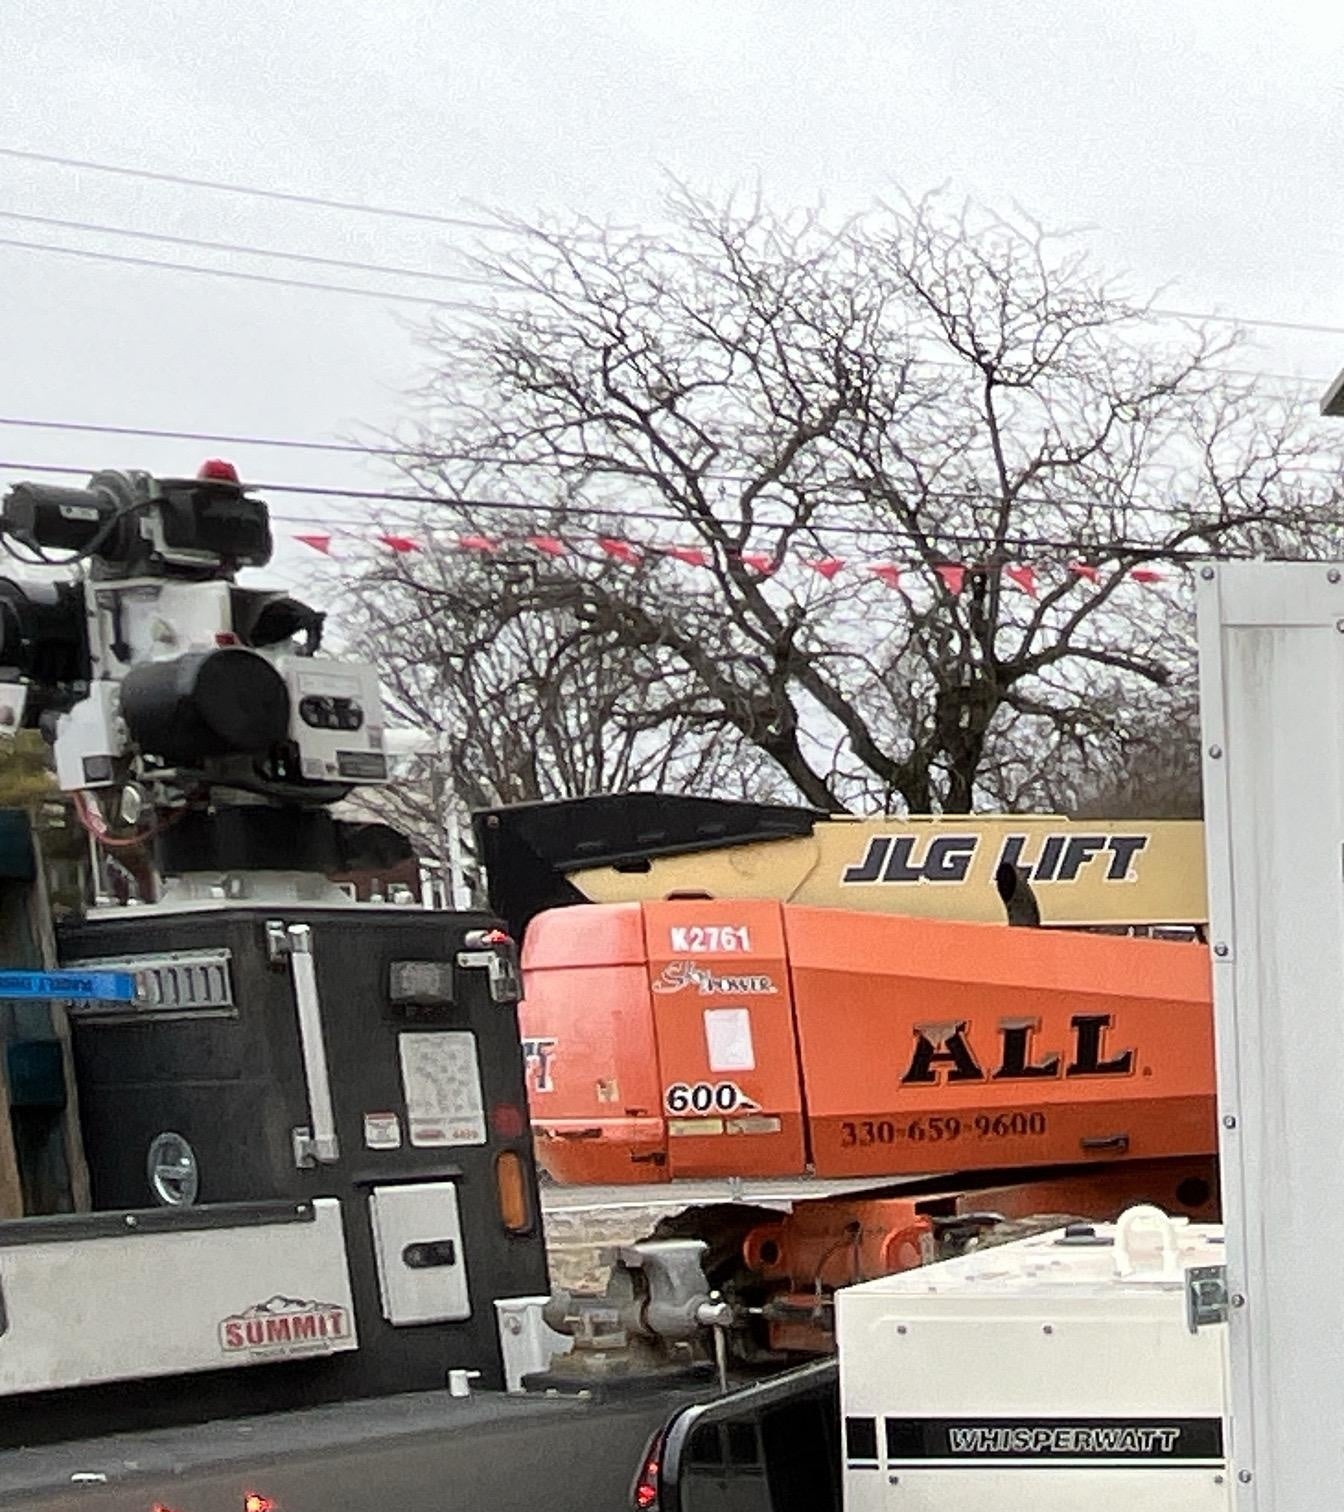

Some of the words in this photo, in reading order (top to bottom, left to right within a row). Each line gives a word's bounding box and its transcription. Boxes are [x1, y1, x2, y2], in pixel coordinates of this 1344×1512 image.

[843, 837, 978, 882] JLG
[997, 837, 1147, 881] LIFT
[670, 926, 750, 952] K2761
[899, 1013, 1136, 1084] ALL
[667, 1084, 738, 1112] 600
[841, 1111, 1048, 1148] 330-659-9600
[225, 1310, 342, 1347] SUMMIT
[949, 1428, 1181, 1452] WHISPERWATT
